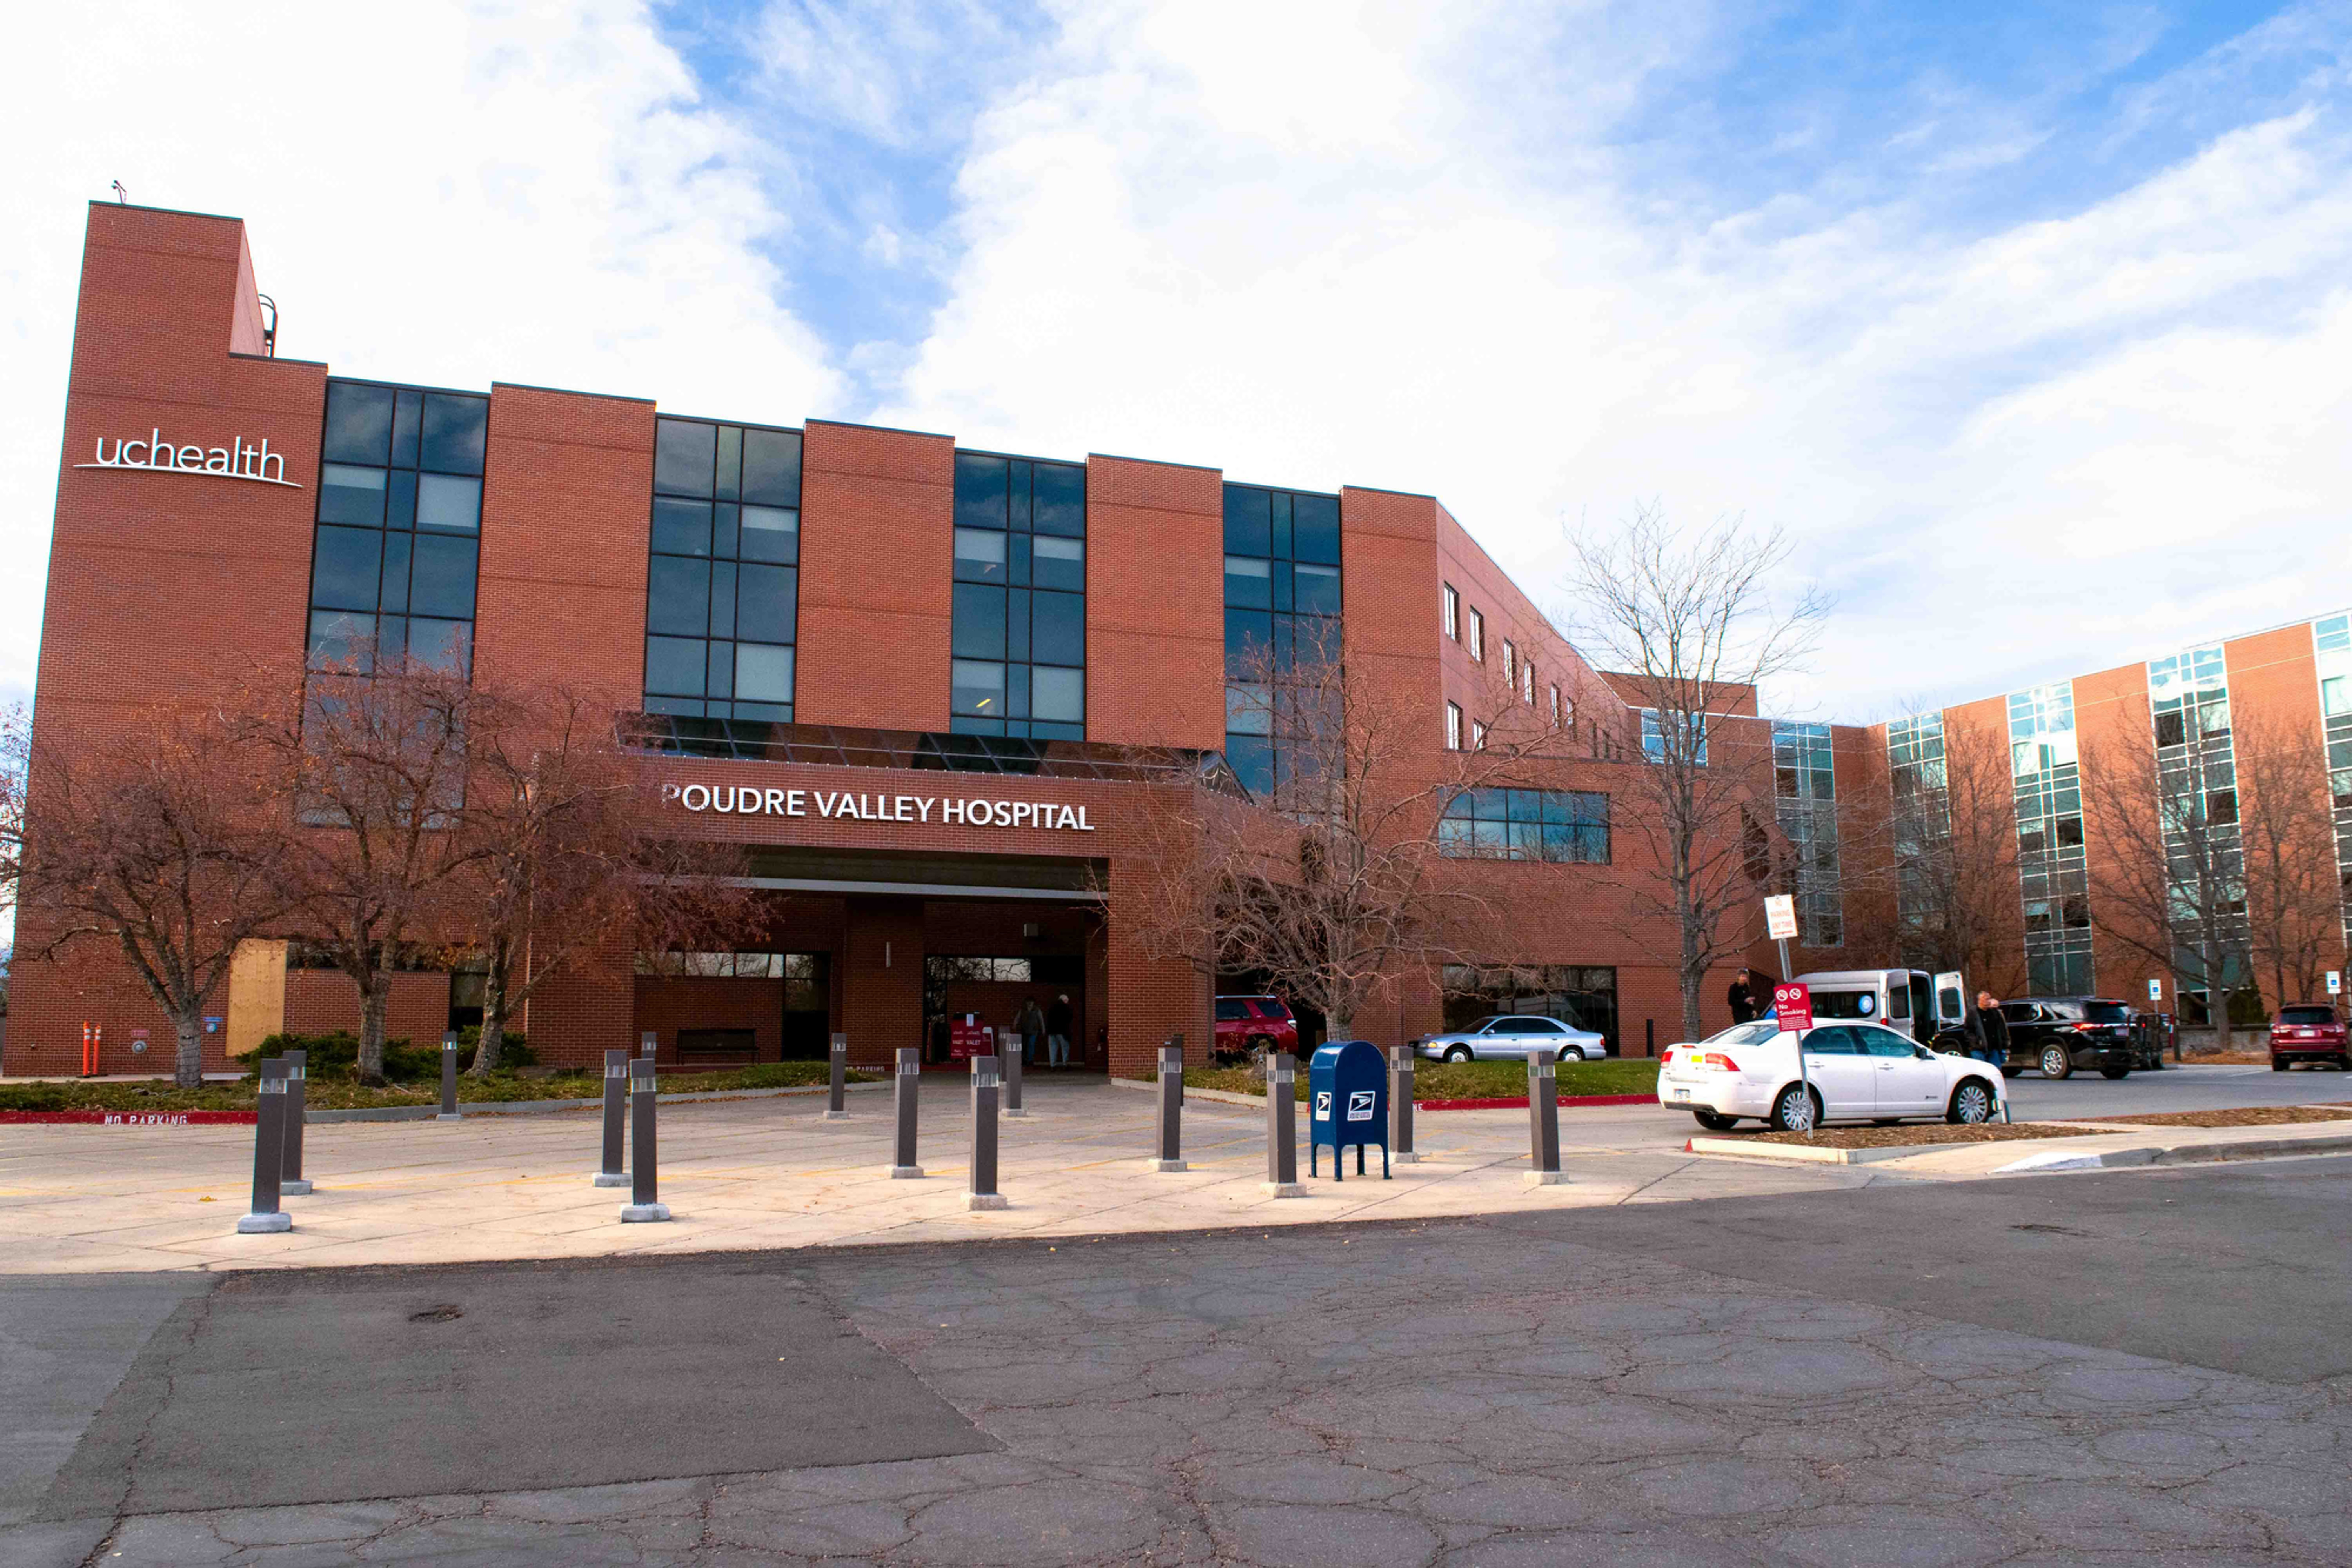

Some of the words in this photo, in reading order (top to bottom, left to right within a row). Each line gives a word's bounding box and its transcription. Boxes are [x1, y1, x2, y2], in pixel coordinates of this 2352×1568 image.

[96, 428, 284, 481] uchealth
[813, 791, 935, 822] VALLEY
[942, 798, 1095, 831] HOSPITAL
[105, 1115, 121, 1124] NO
[129, 1115, 187, 1125] PARKING
